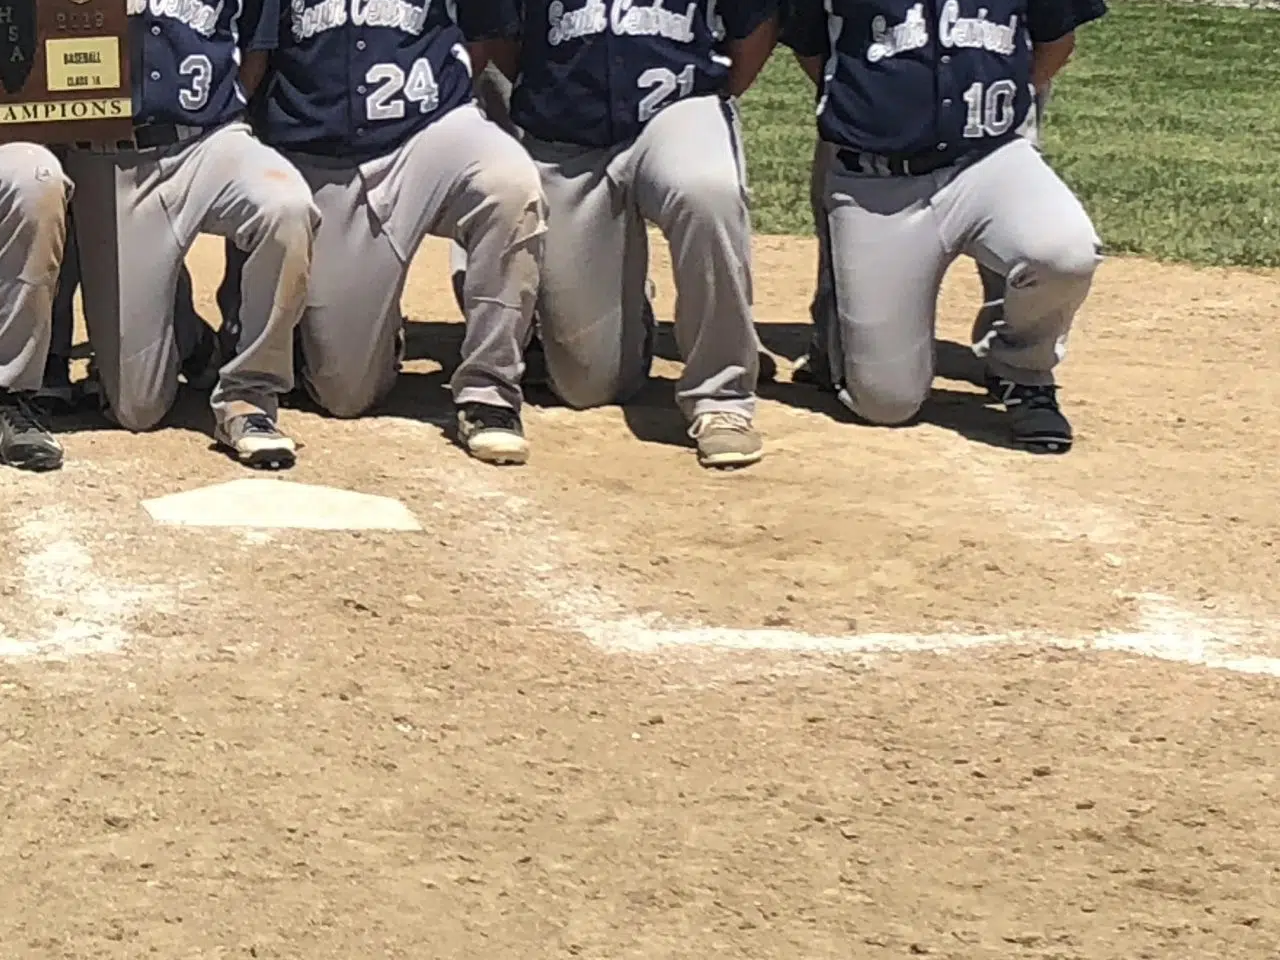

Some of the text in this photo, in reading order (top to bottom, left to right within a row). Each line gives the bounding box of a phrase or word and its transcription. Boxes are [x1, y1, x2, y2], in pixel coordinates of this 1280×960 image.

[939, 0, 1017, 56] Central
[179, 54, 212, 111] 3
[365, 57, 440, 120] 24
[963, 79, 1017, 138] 10
